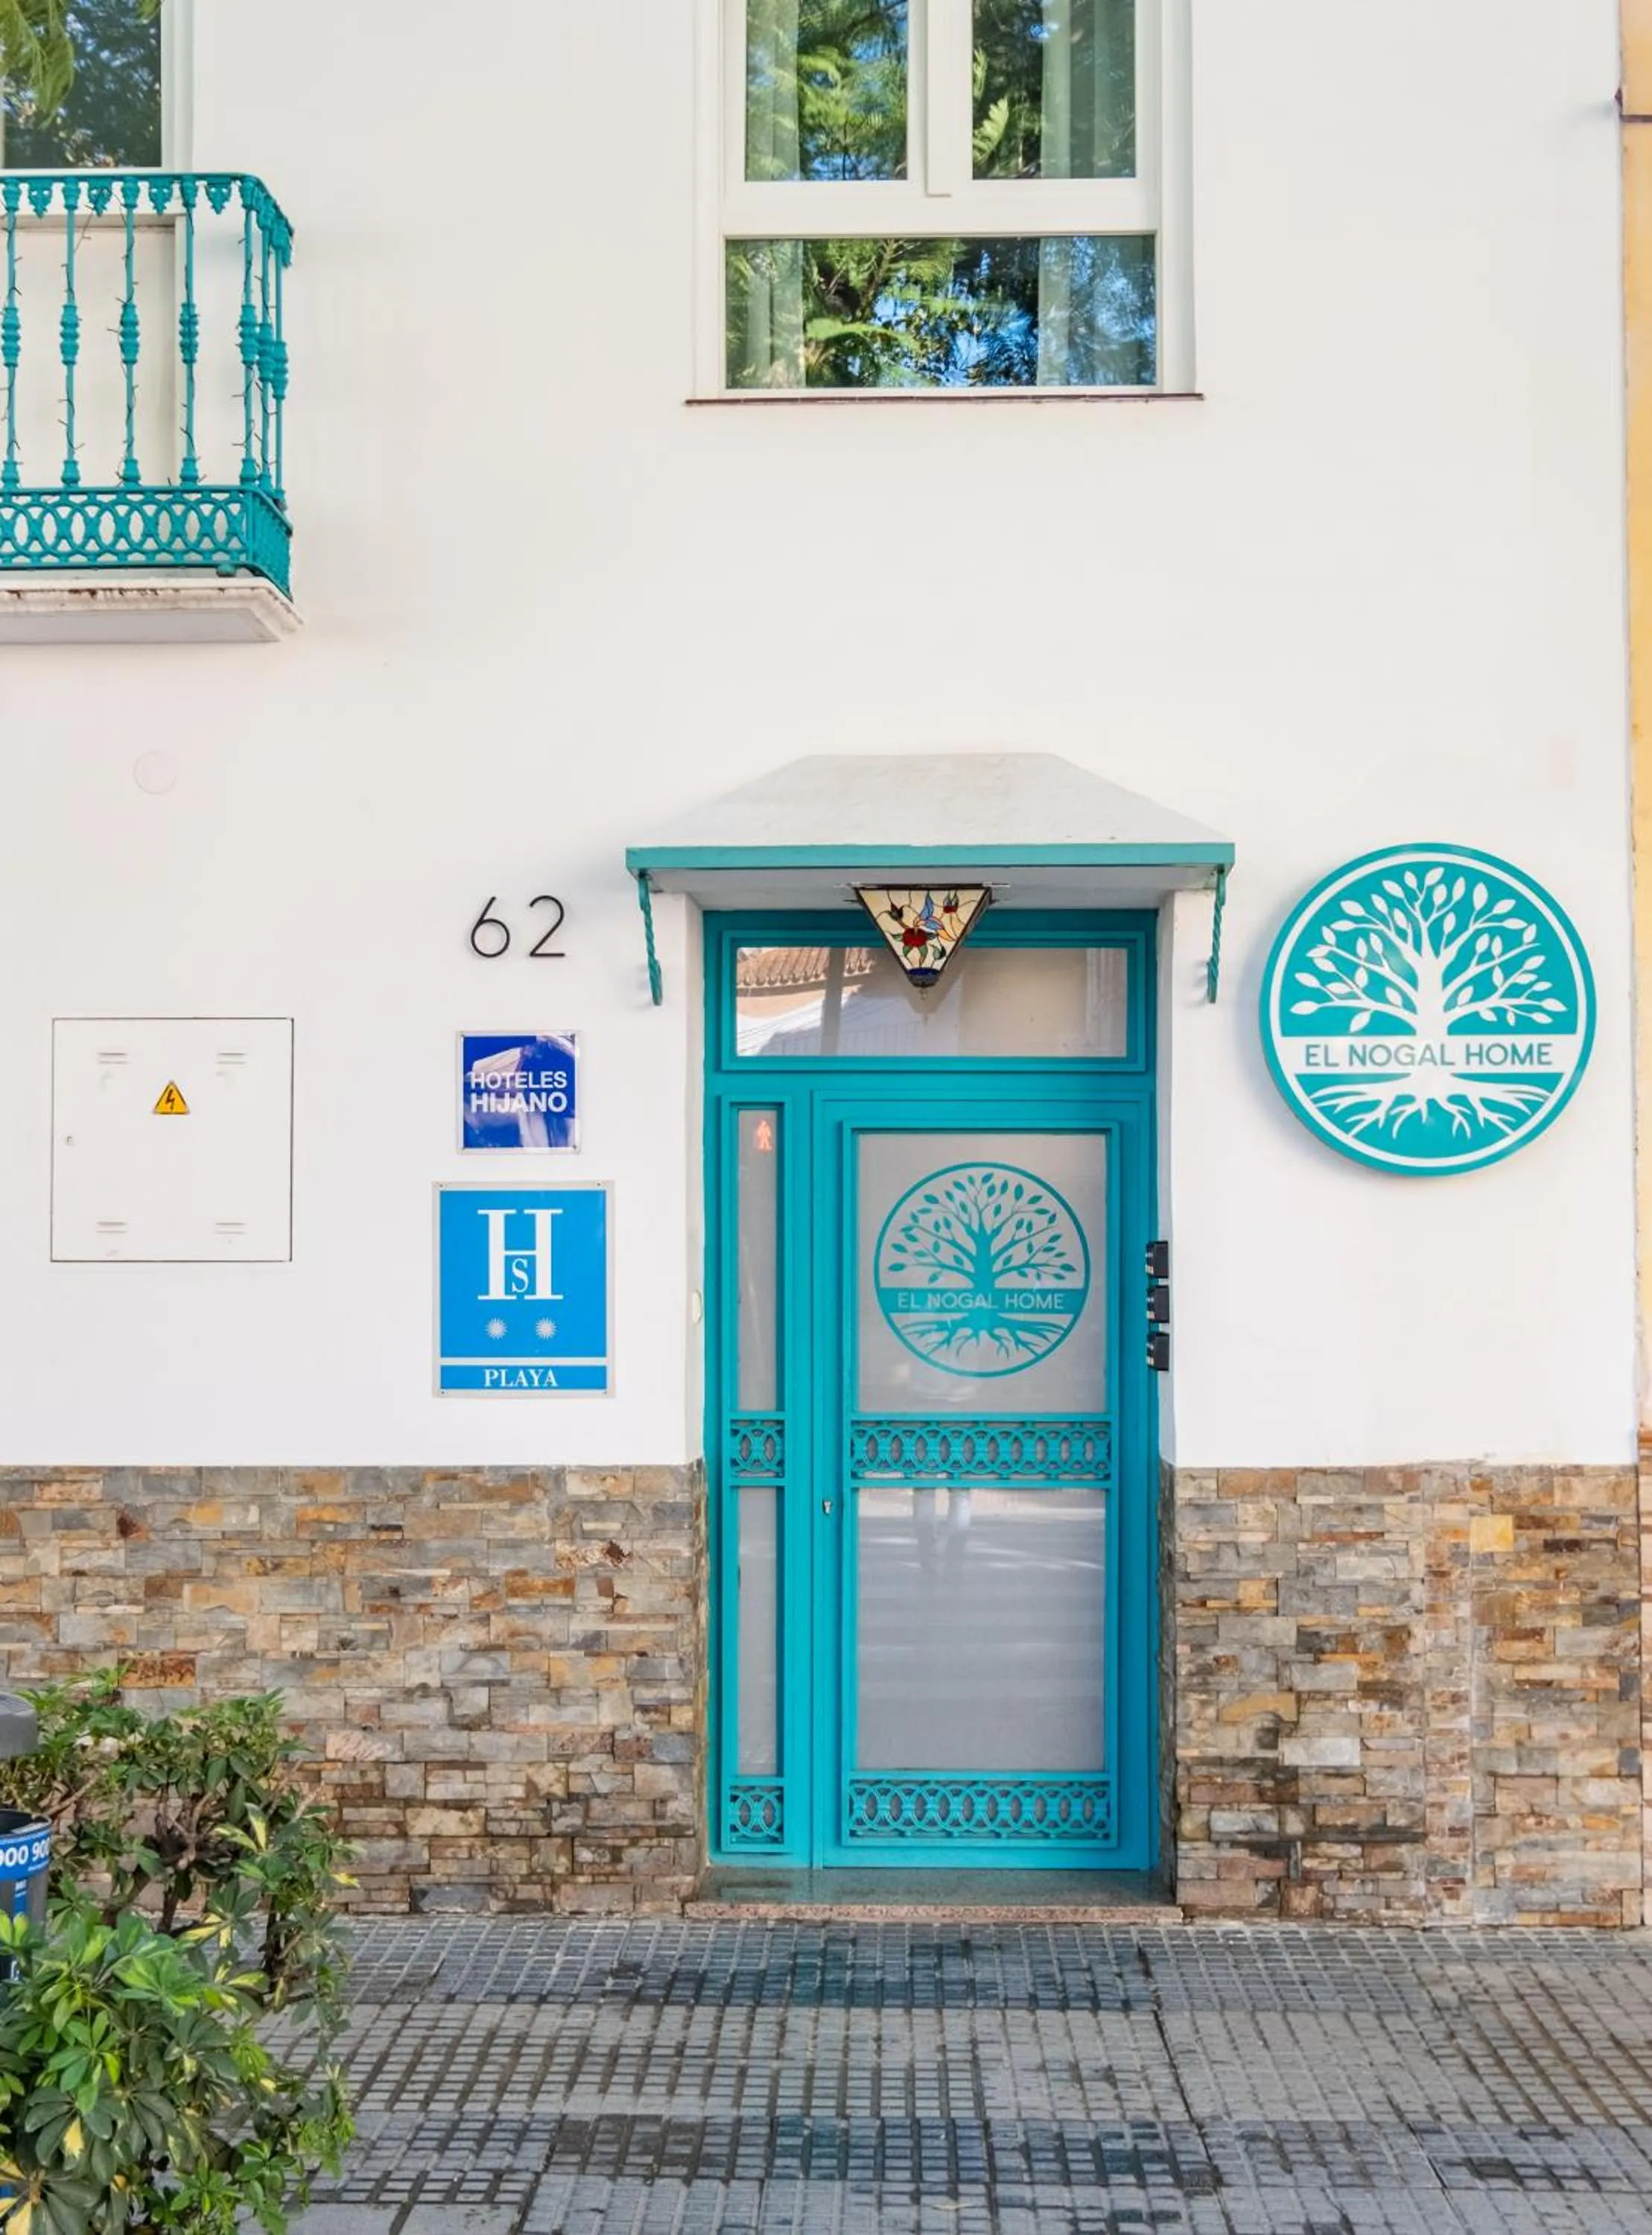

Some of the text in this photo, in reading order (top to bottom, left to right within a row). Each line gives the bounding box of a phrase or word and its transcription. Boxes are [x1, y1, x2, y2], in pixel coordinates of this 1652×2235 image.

[471, 895, 565, 957] 62
[1305, 1043, 1552, 1067] EL NOGAL HOME
[471, 1071, 567, 1088] HOTELES
[471, 1092, 567, 1112] HIJANO
[898, 1293, 1064, 1308] EL NOGAL HOME
[483, 1369, 559, 1387] PLAYA
